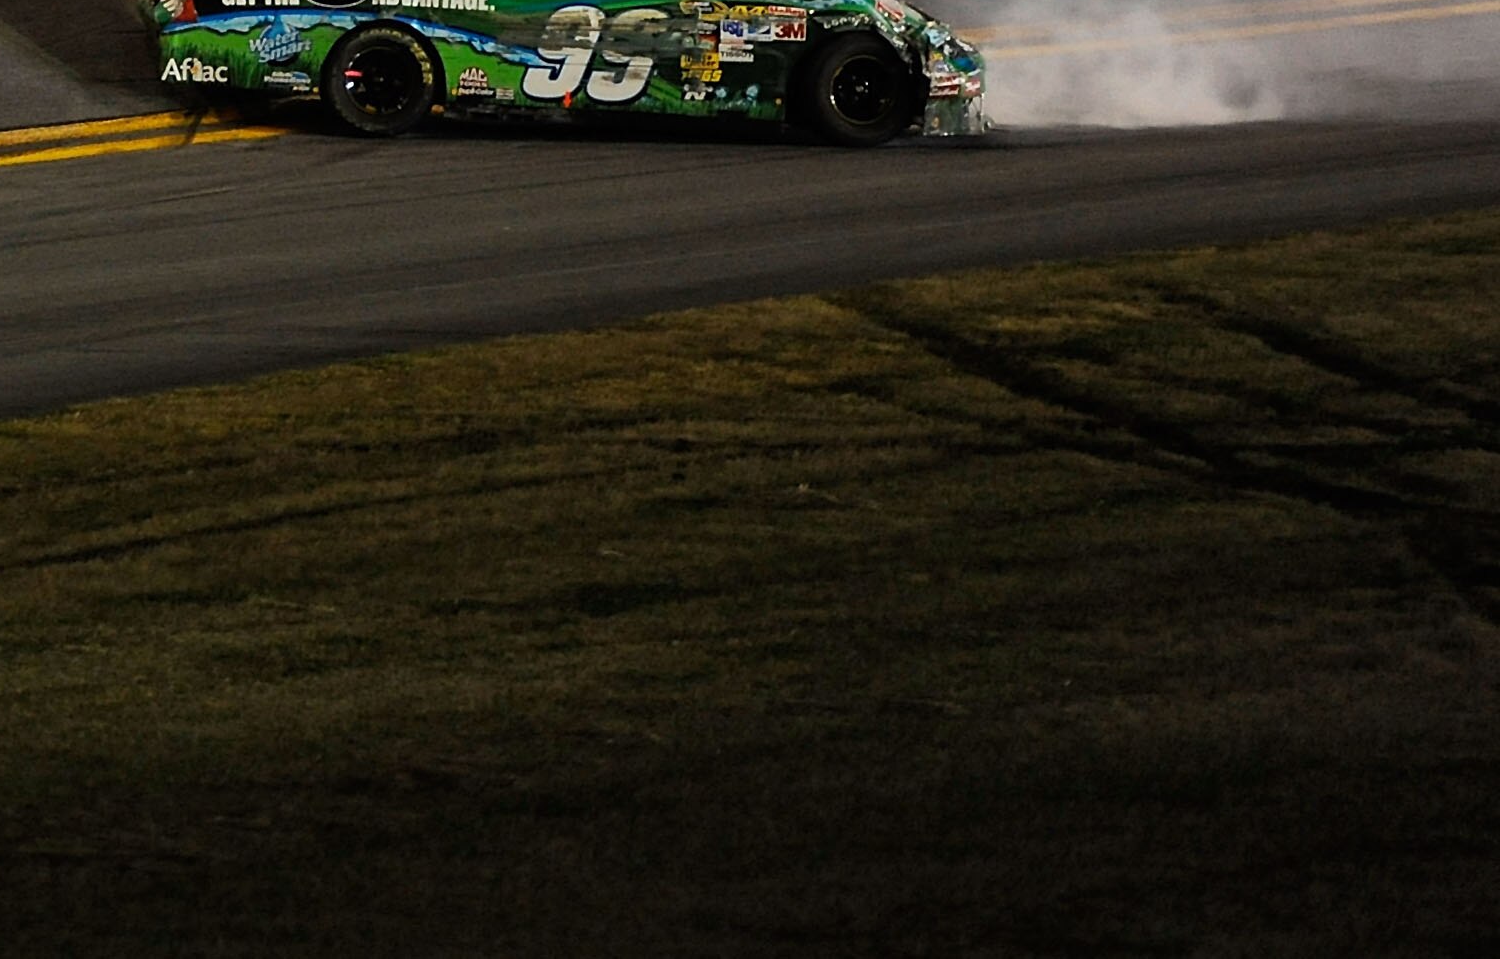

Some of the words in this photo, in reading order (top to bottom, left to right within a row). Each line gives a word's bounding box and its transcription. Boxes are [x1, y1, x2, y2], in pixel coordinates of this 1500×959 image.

[249, 31, 299, 52] Water
[775, 22, 805, 40] 3M
[259, 39, 312, 63] Smart
[161, 57, 229, 83] Aflac
[459, 68, 488, 81] MAC
